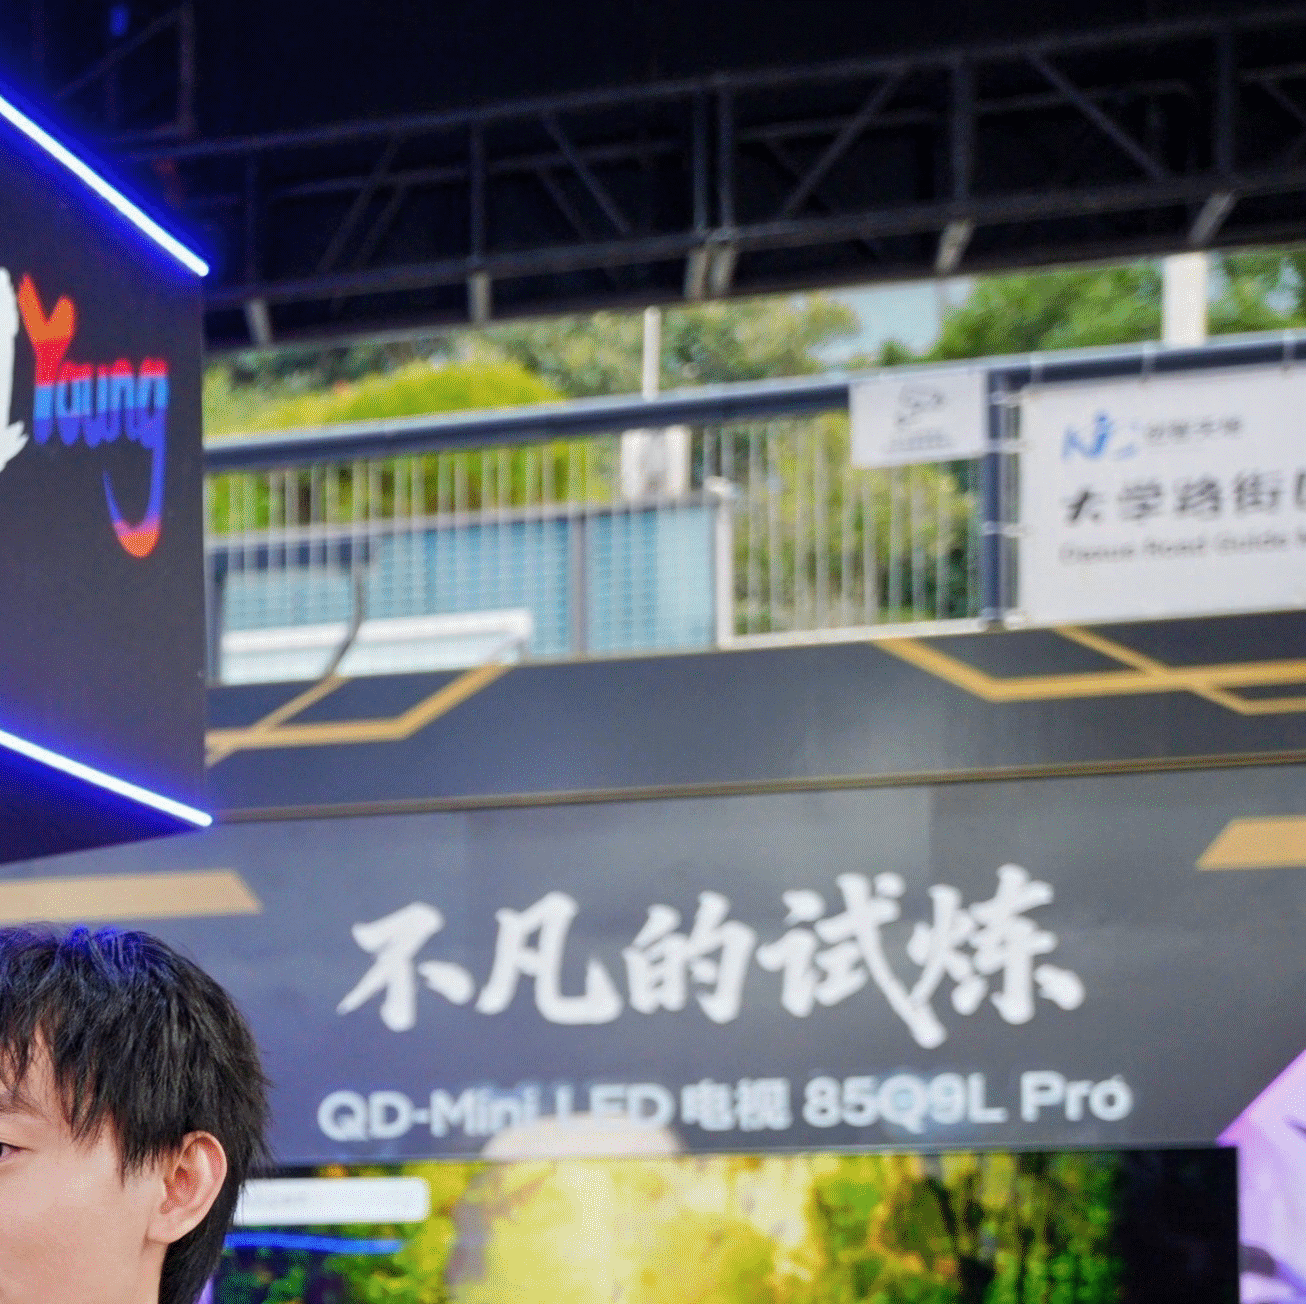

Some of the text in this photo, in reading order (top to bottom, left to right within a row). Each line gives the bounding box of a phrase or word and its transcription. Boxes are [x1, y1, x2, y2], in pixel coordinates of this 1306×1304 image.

[18, 272, 169, 557] Young
[1061, 468, 1306, 526] 大学路街
[337, 865, 1084, 1048] 不凡的试炼
[681, 1078, 792, 1132] 电视
[804, 1072, 1006, 1128] 85Q9L
[1023, 1070, 1133, 1122] Pro
